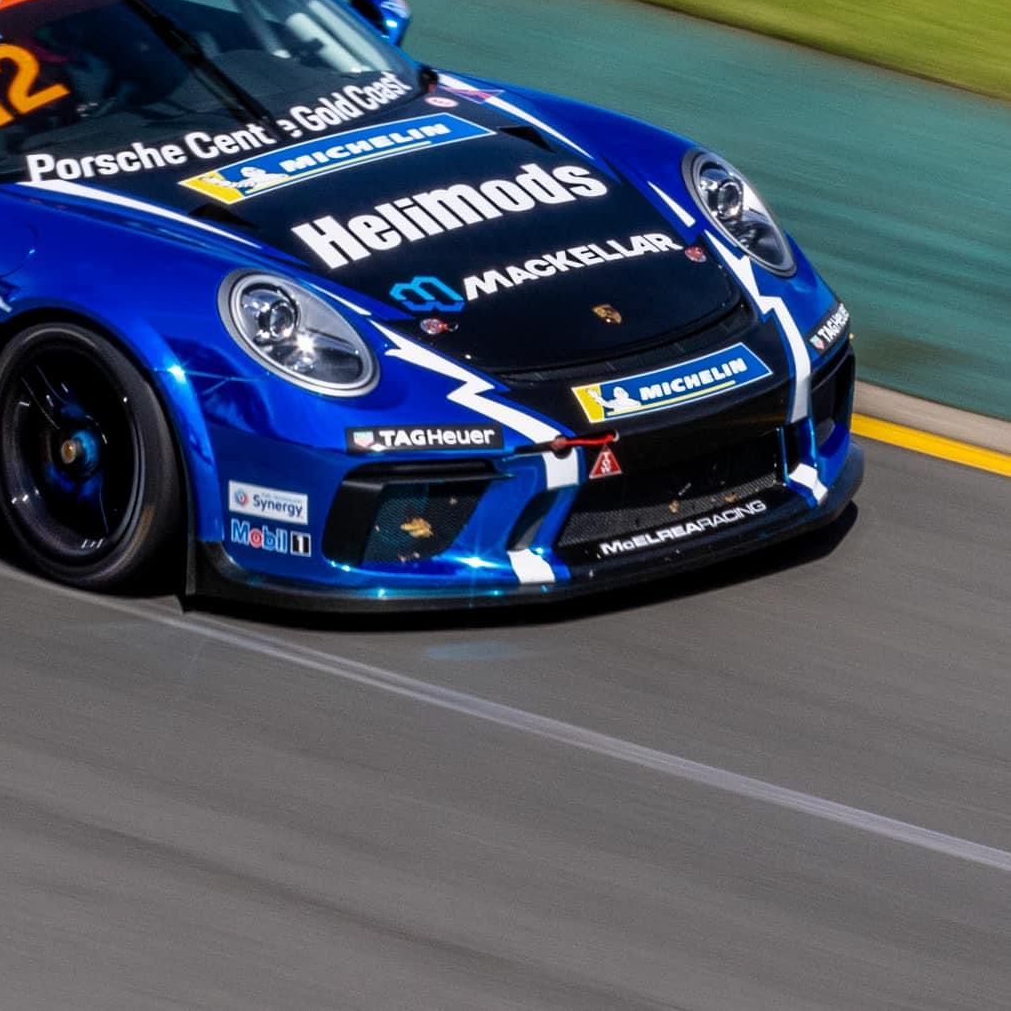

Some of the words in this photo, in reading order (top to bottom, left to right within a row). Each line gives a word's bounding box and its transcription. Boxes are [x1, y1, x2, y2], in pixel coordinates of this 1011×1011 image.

[26, 139, 185, 182] Porsche
[186, 117, 297, 161] Cente
[289, 86, 356, 135] Gold
[349, 71, 413, 113] Coast
[280, 122, 452, 173] MICHELIN
[462, 232, 683, 301] MACKELLAR
[639, 358, 747, 401] MICHELIN
[252, 494, 303, 518] Synergy
[230, 518, 288, 555] Mobil
